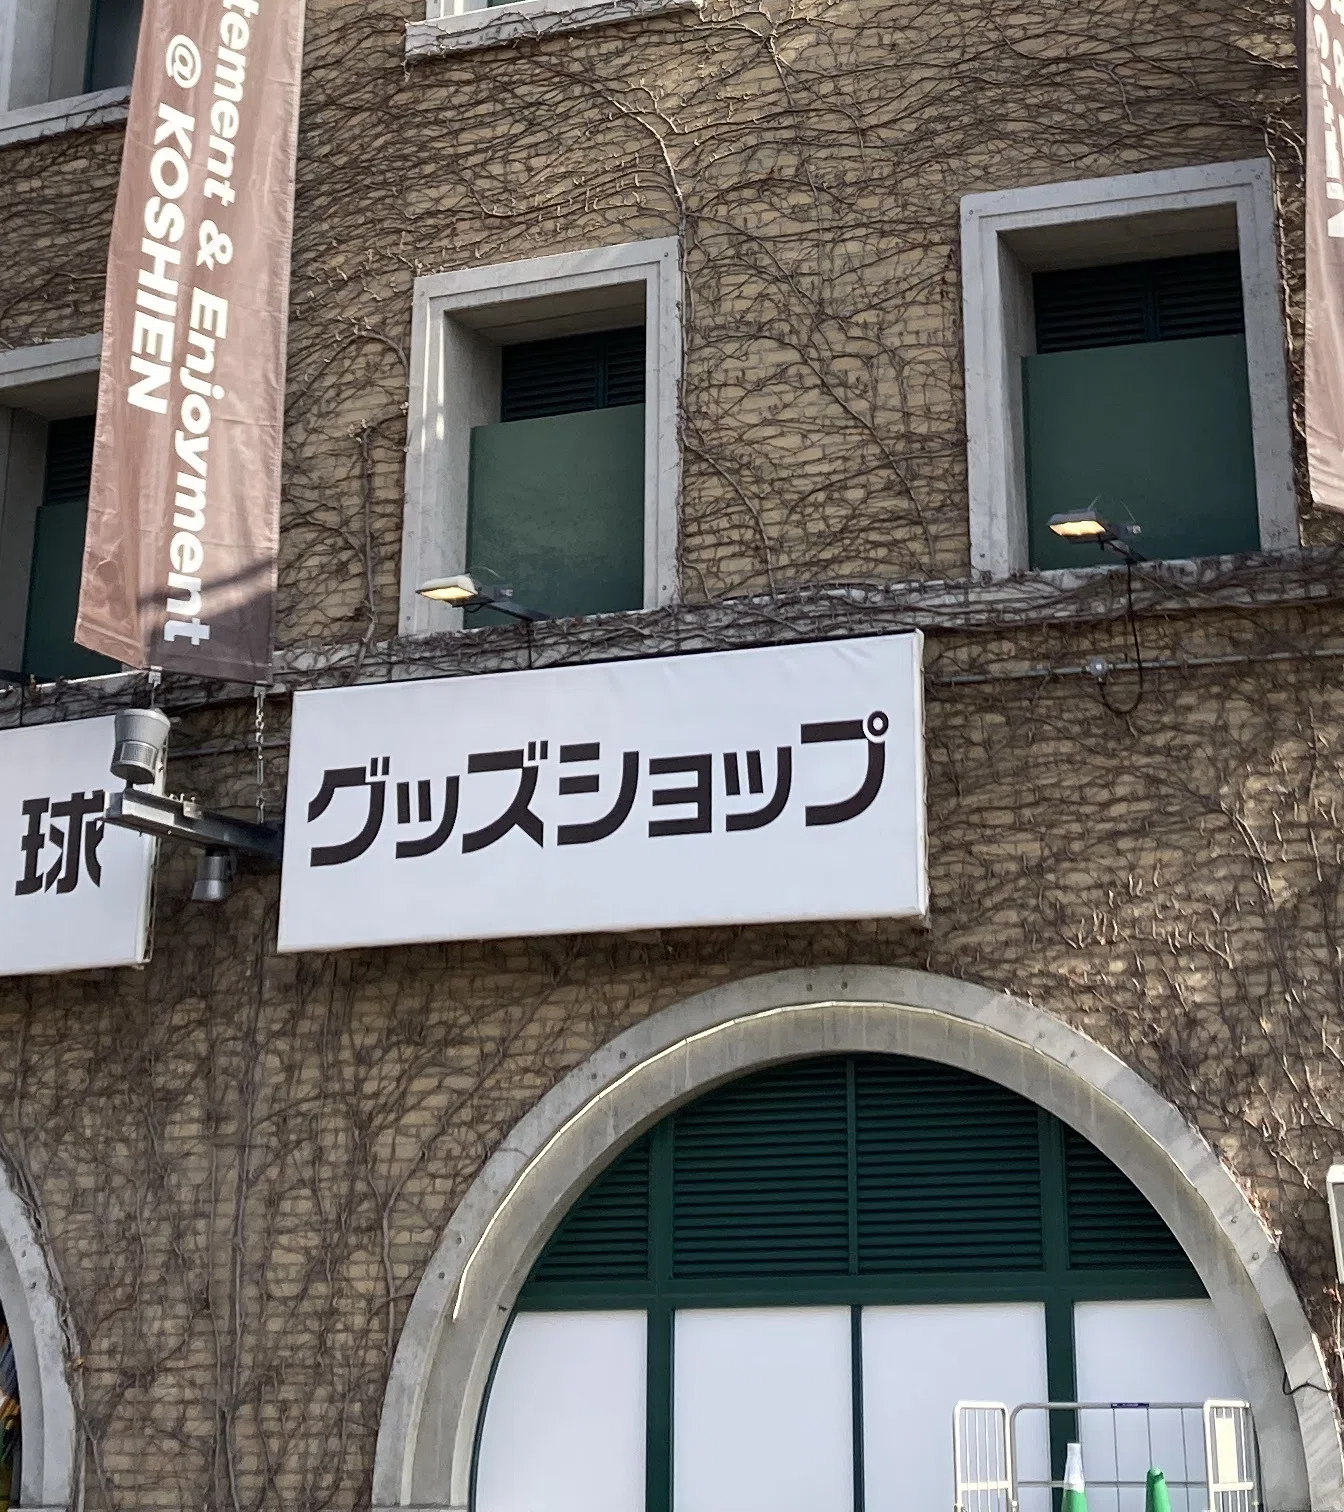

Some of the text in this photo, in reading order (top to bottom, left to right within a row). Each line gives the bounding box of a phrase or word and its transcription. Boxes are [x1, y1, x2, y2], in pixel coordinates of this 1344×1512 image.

[127, 34, 202, 415] @ KOSHIEN
[196, 219, 234, 271] &
[163, 287, 228, 646] Enjoyment
[308, 710, 890, 868] グッズショップ
